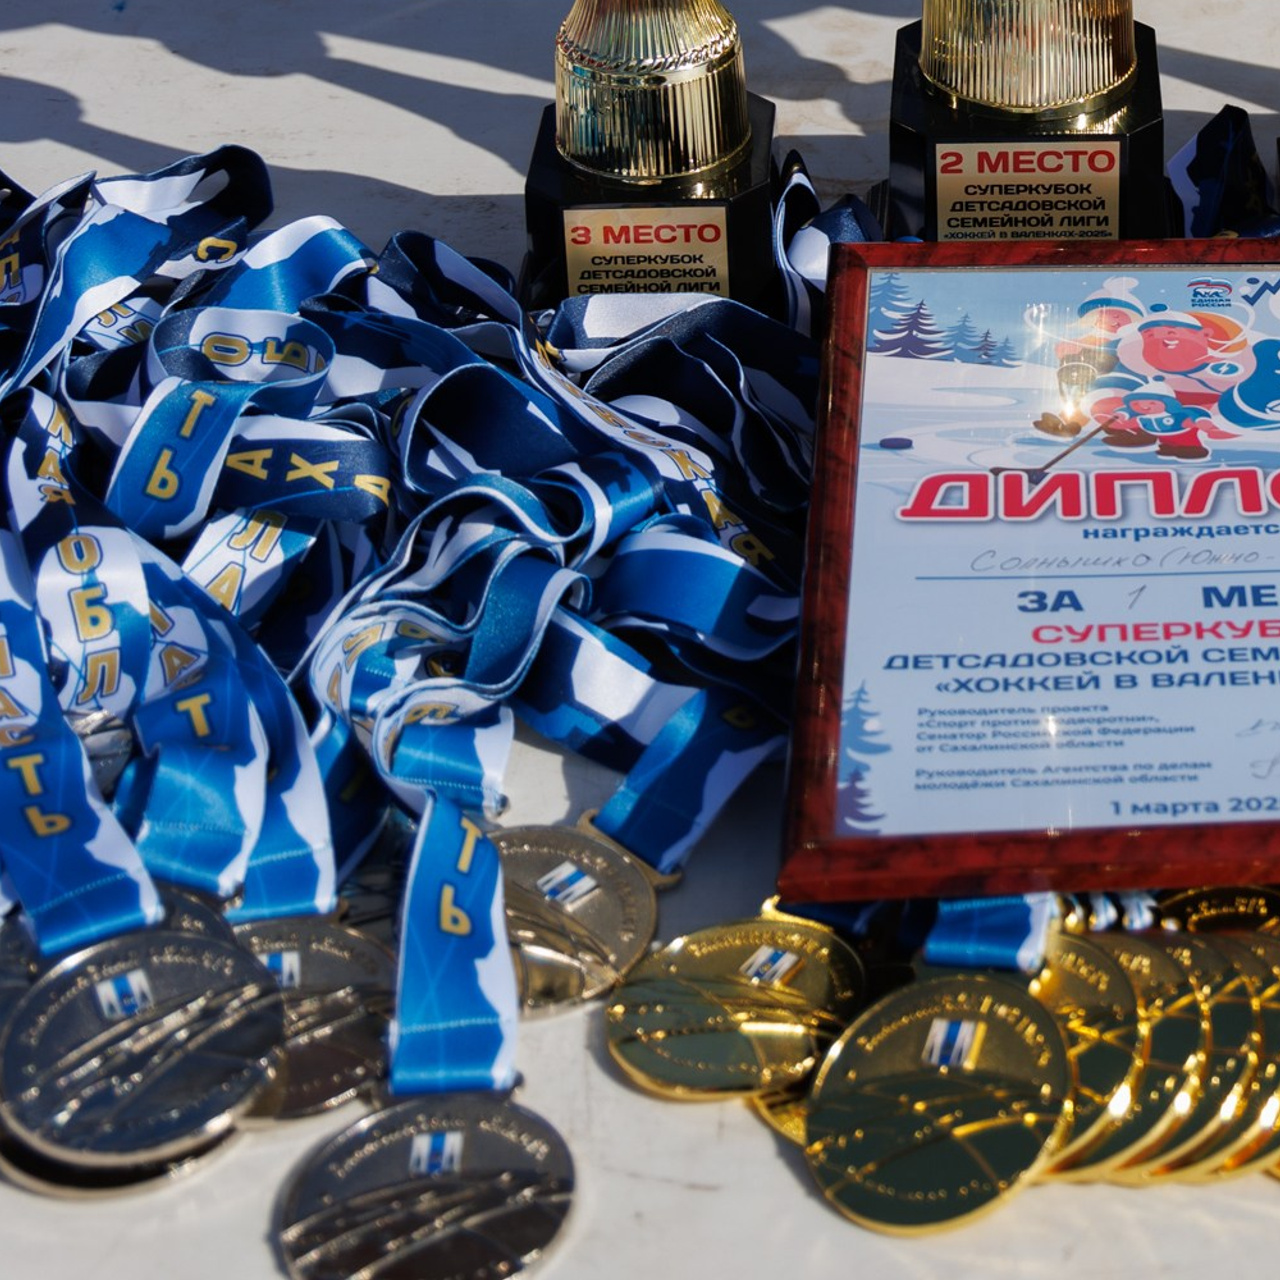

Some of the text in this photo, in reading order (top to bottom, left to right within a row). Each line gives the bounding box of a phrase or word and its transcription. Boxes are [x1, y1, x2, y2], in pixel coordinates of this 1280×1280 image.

[939, 150, 1116, 174] 2 МЕСТО
[963, 183, 1093, 196] СУПЕРКУБОК
[949, 196, 1106, 212] ДЕТСАДОВСКОЙ
[947, 213, 1110, 228] СЕМЕЙНОЙ ЛИГИ
[570, 223, 722, 245] 3 МЕСТО
[591, 254, 704, 266] СУПЕРКУБОК
[579, 265, 717, 280] ДЕТСАДОВСКОЙ
[576, 280, 721, 294] СЕМЕЙНОЙ ЛИГИ
[1017, 589, 1084, 614] ЗА
[882, 644, 1190, 670] ДЕТСАДОВСКОЙ
[935, 669, 1101, 694] «ХОККЕЙ
[1114, 672, 1139, 690] В
[1109, 800, 1120, 815] 1
[1130, 800, 1221, 817] марта
